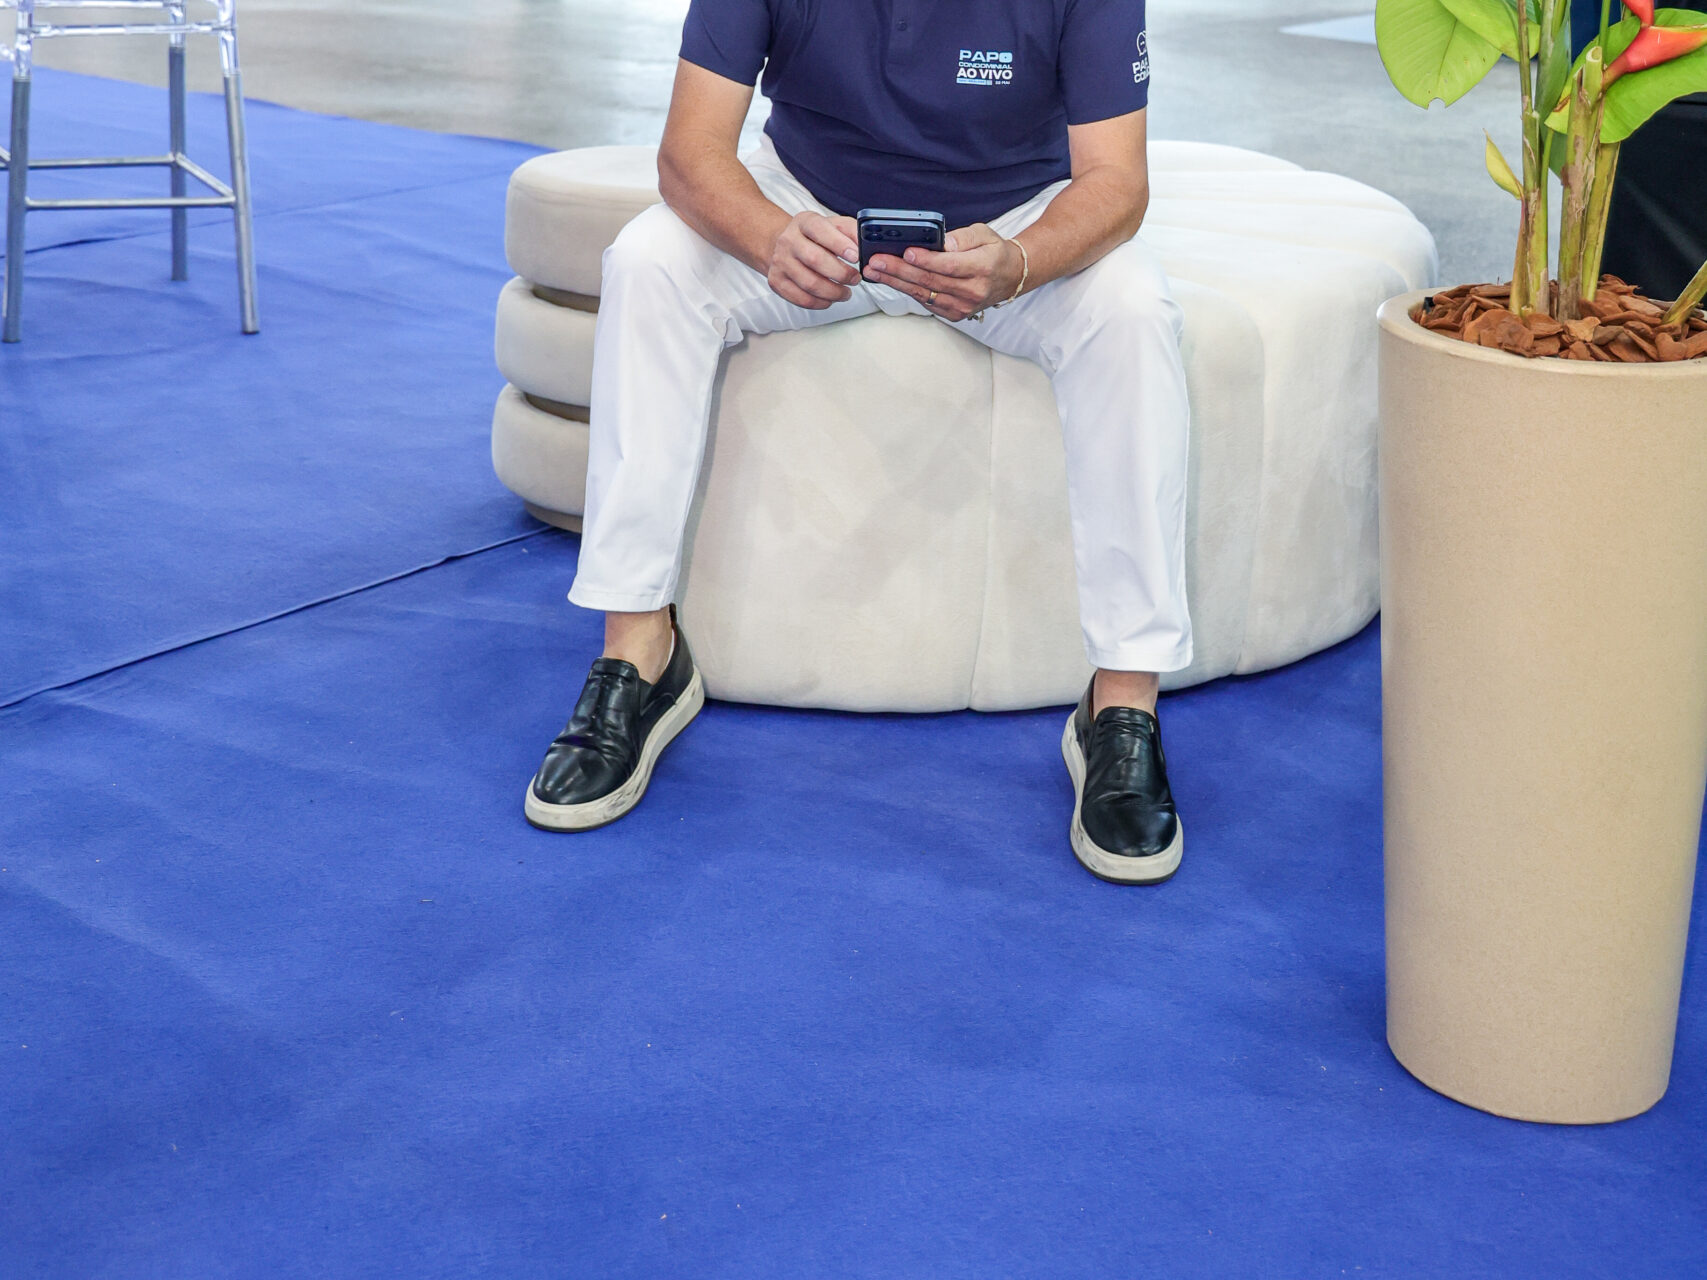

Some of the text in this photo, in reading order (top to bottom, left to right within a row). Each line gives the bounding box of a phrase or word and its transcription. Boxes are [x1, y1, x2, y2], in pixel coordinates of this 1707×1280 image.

[959, 49, 1013, 63] PAPO
[958, 61, 1013, 70] CONDOMINIAL
[956, 67, 1013, 80] AO VIVO
